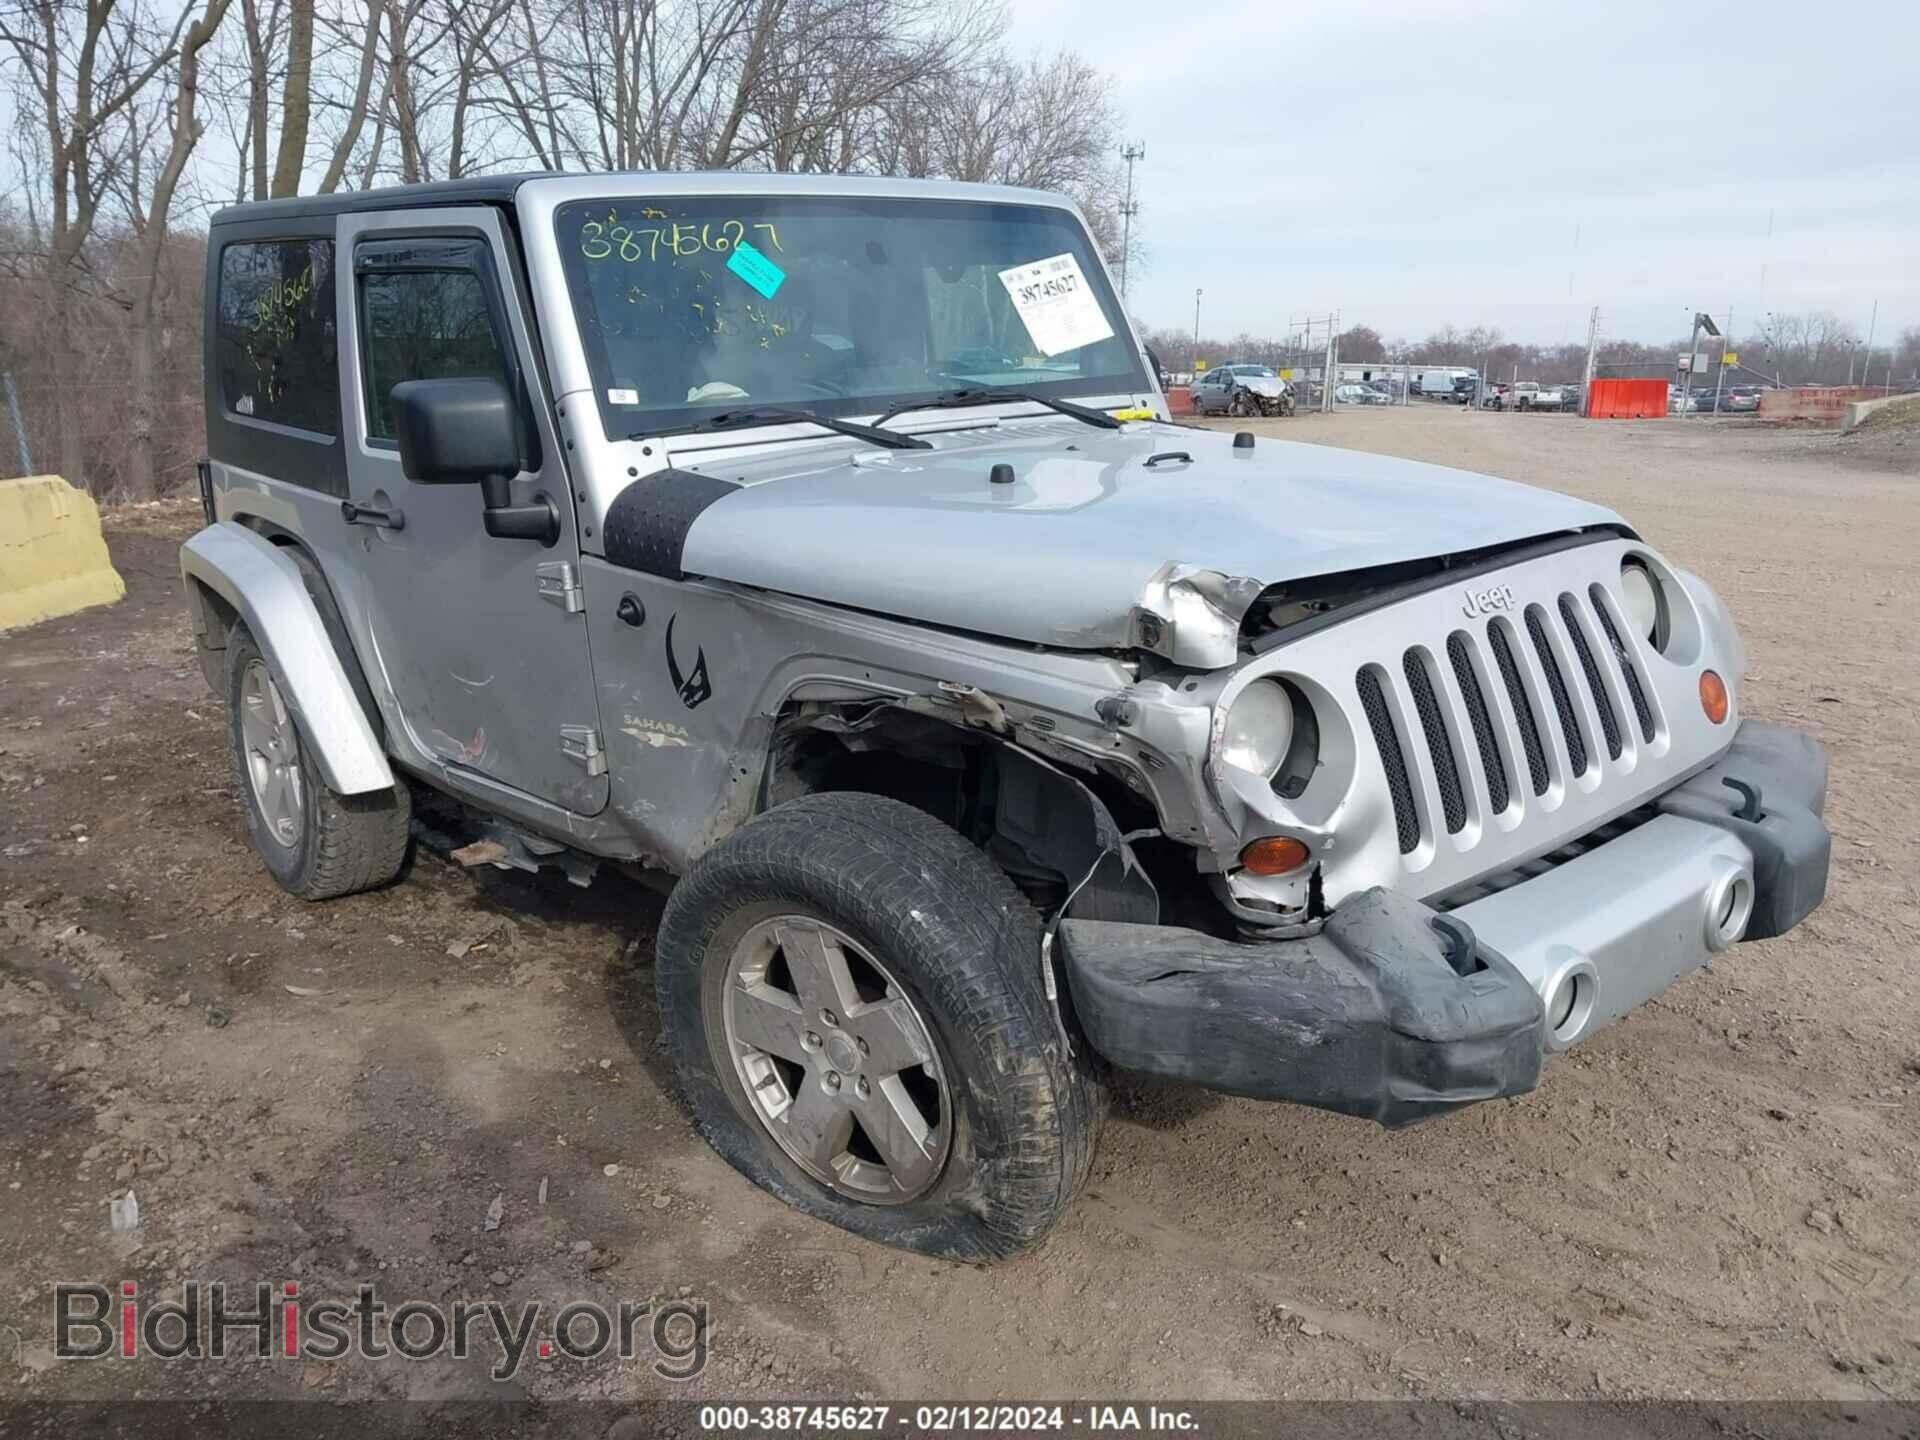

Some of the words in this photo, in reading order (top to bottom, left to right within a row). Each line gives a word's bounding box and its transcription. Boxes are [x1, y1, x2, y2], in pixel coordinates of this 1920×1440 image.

[581, 221, 784, 263] 38745627
[1018, 274, 1078, 304] 38745627
[1462, 584, 1515, 619] Jeep
[623, 713, 689, 737] SAHARA
